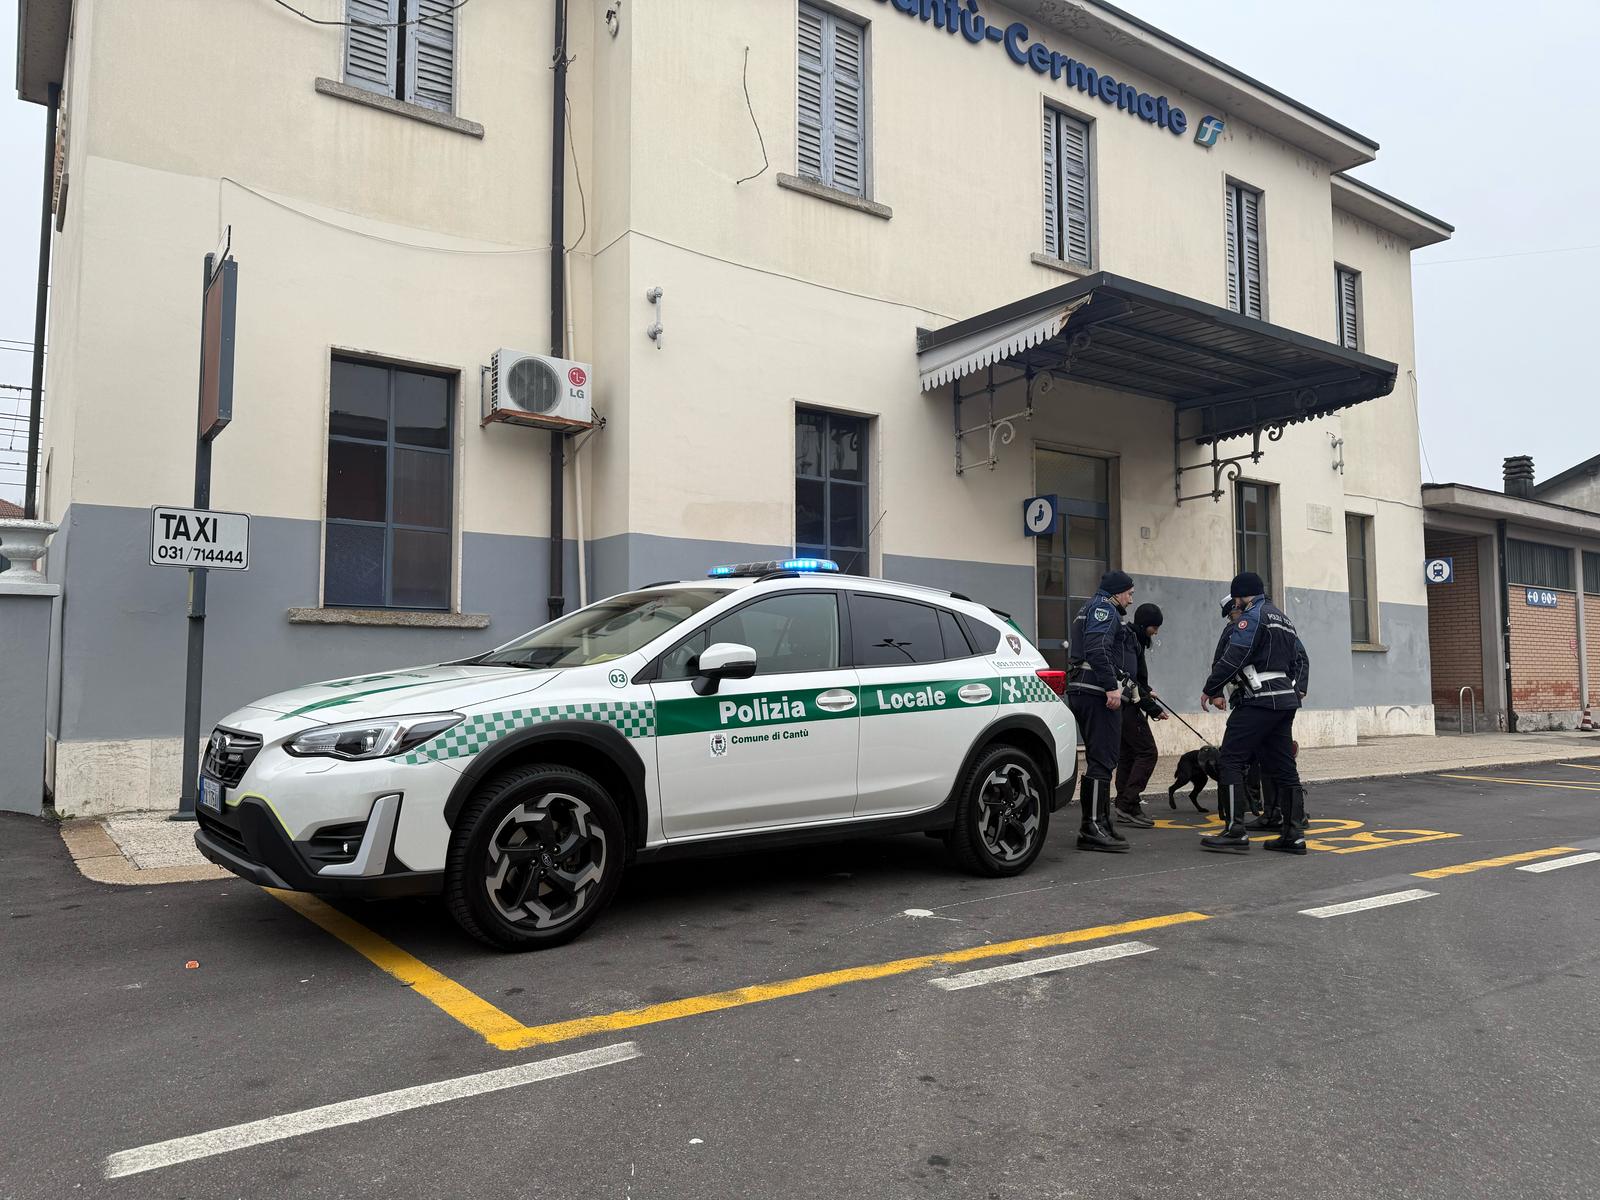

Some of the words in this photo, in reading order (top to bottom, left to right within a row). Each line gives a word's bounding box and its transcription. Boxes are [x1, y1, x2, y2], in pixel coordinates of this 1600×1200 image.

[874, 0, 1188, 135] antù-Cermenate
[570, 388, 584, 399] LG
[159, 513, 217, 543] TAXI
[158, 545, 243, 564] 031/714444
[611, 674, 625, 683] 03
[719, 696, 806, 724] Polizia
[877, 686, 946, 710] Locale
[731, 733, 769, 744] Comune
[772, 732, 780, 740] di
[783, 729, 809, 739] Cantù
